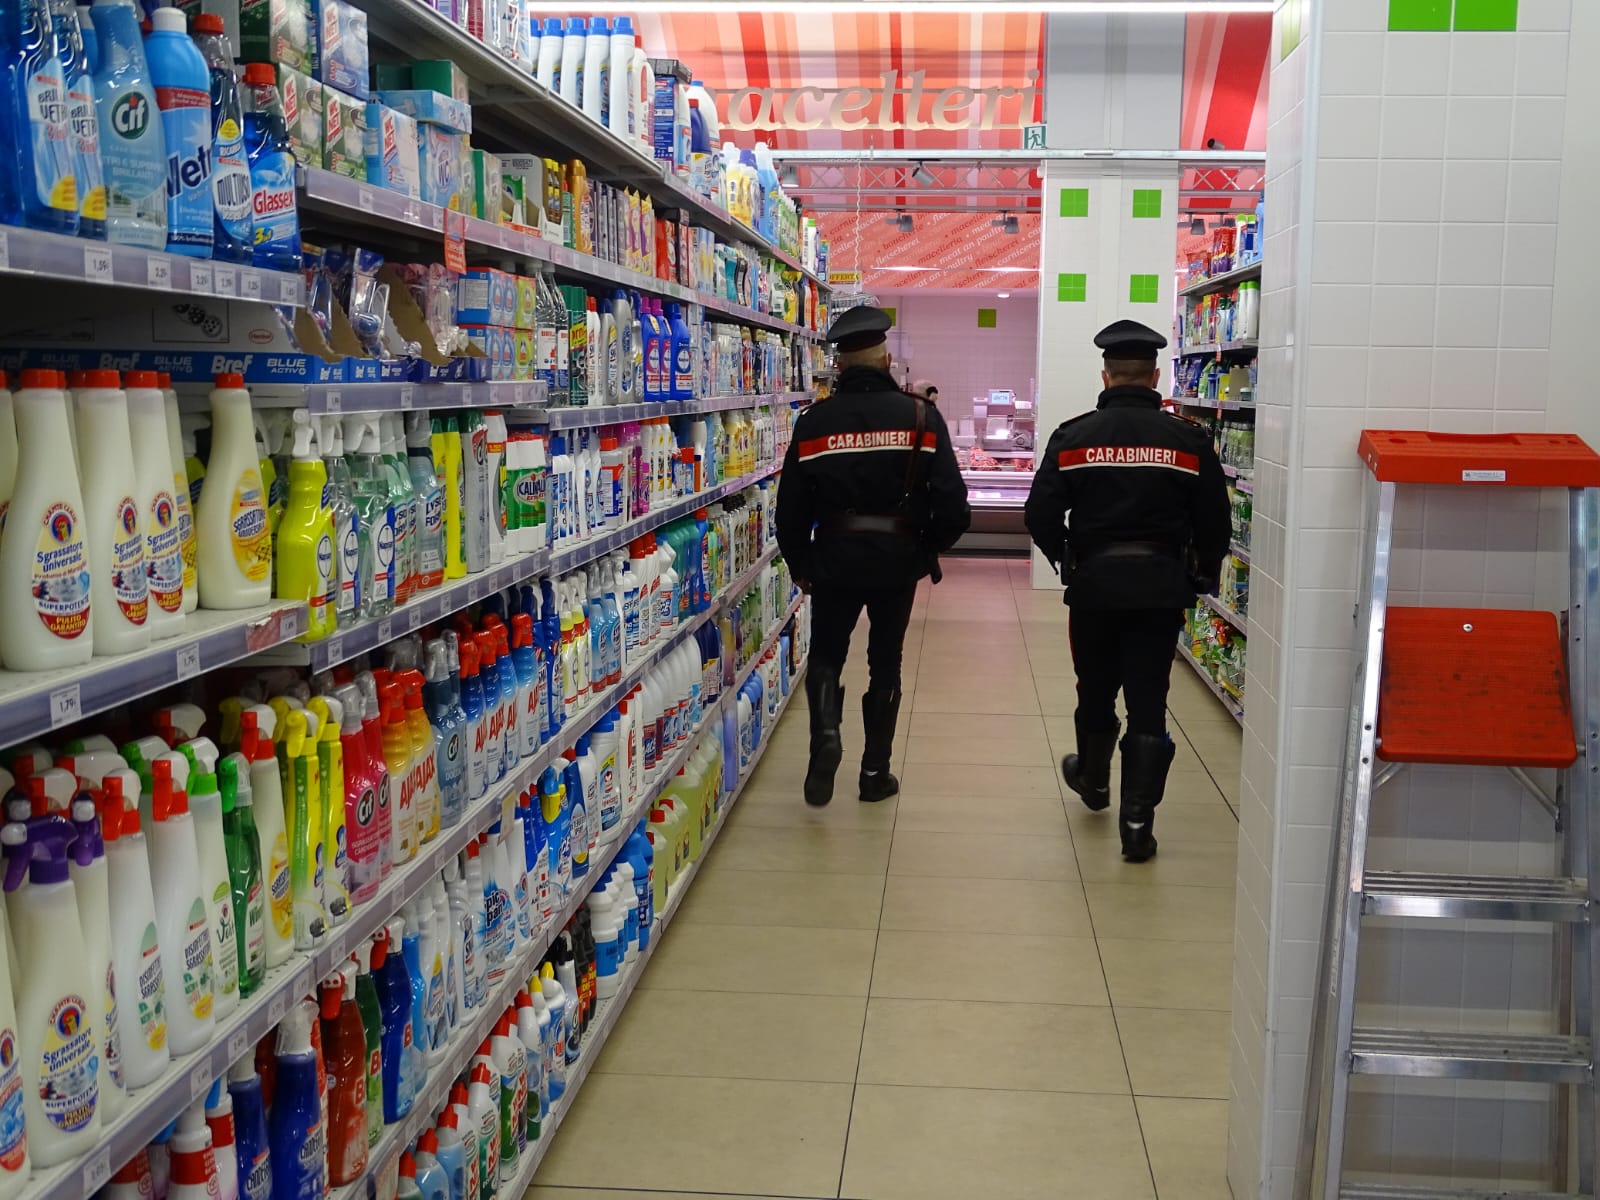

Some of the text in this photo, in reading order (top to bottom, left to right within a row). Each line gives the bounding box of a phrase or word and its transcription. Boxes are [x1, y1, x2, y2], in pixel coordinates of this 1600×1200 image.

[714, 68, 1043, 131] acelleri
[115, 96, 145, 133] Cif
[253, 189, 294, 215] Glassex
[938, 246, 962, 266] meat
[100, 353, 141, 372] Bref
[154, 356, 193, 366] BLUE
[211, 354, 254, 374] Bref
[267, 358, 307, 368] BLUE
[827, 430, 911, 451] CARABINIERI
[1085, 446, 1177, 466] CARABINIERI
[37, 541, 83, 565] Sgrassatore
[43, 551, 82, 574] universale
[416, 756, 436, 794] AJAX
[358, 792, 374, 825] Cif
[486, 890, 500, 911] pic
[486, 902, 503, 928] pan
[43, 1026, 92, 1066] Sgrassatore
[49, 1038, 91, 1074] universale
